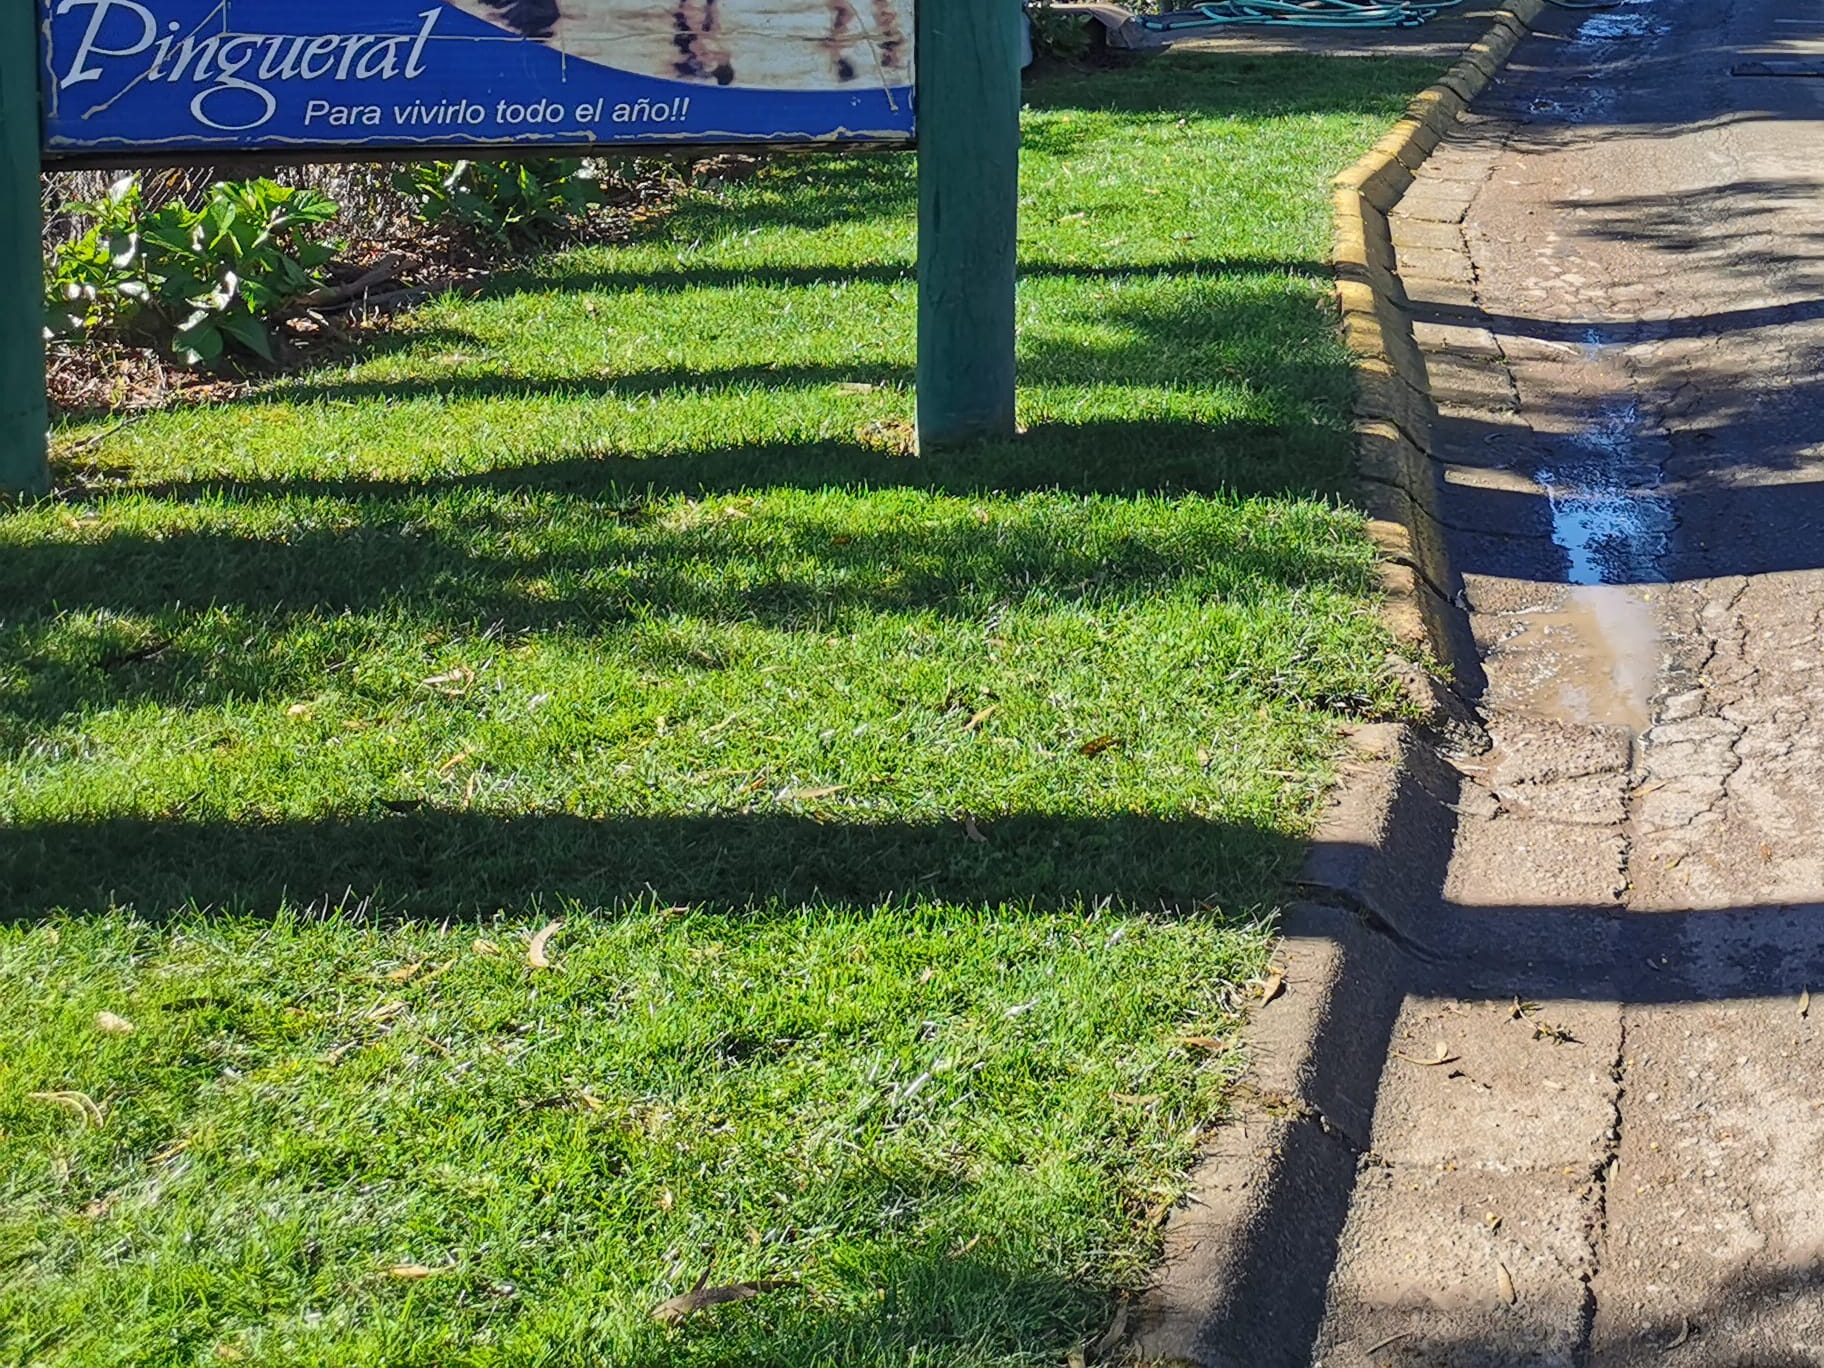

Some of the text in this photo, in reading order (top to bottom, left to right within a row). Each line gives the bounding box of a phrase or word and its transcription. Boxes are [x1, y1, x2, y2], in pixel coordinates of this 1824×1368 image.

[304, 97, 691, 126] Para vivirlo todo el año!!
